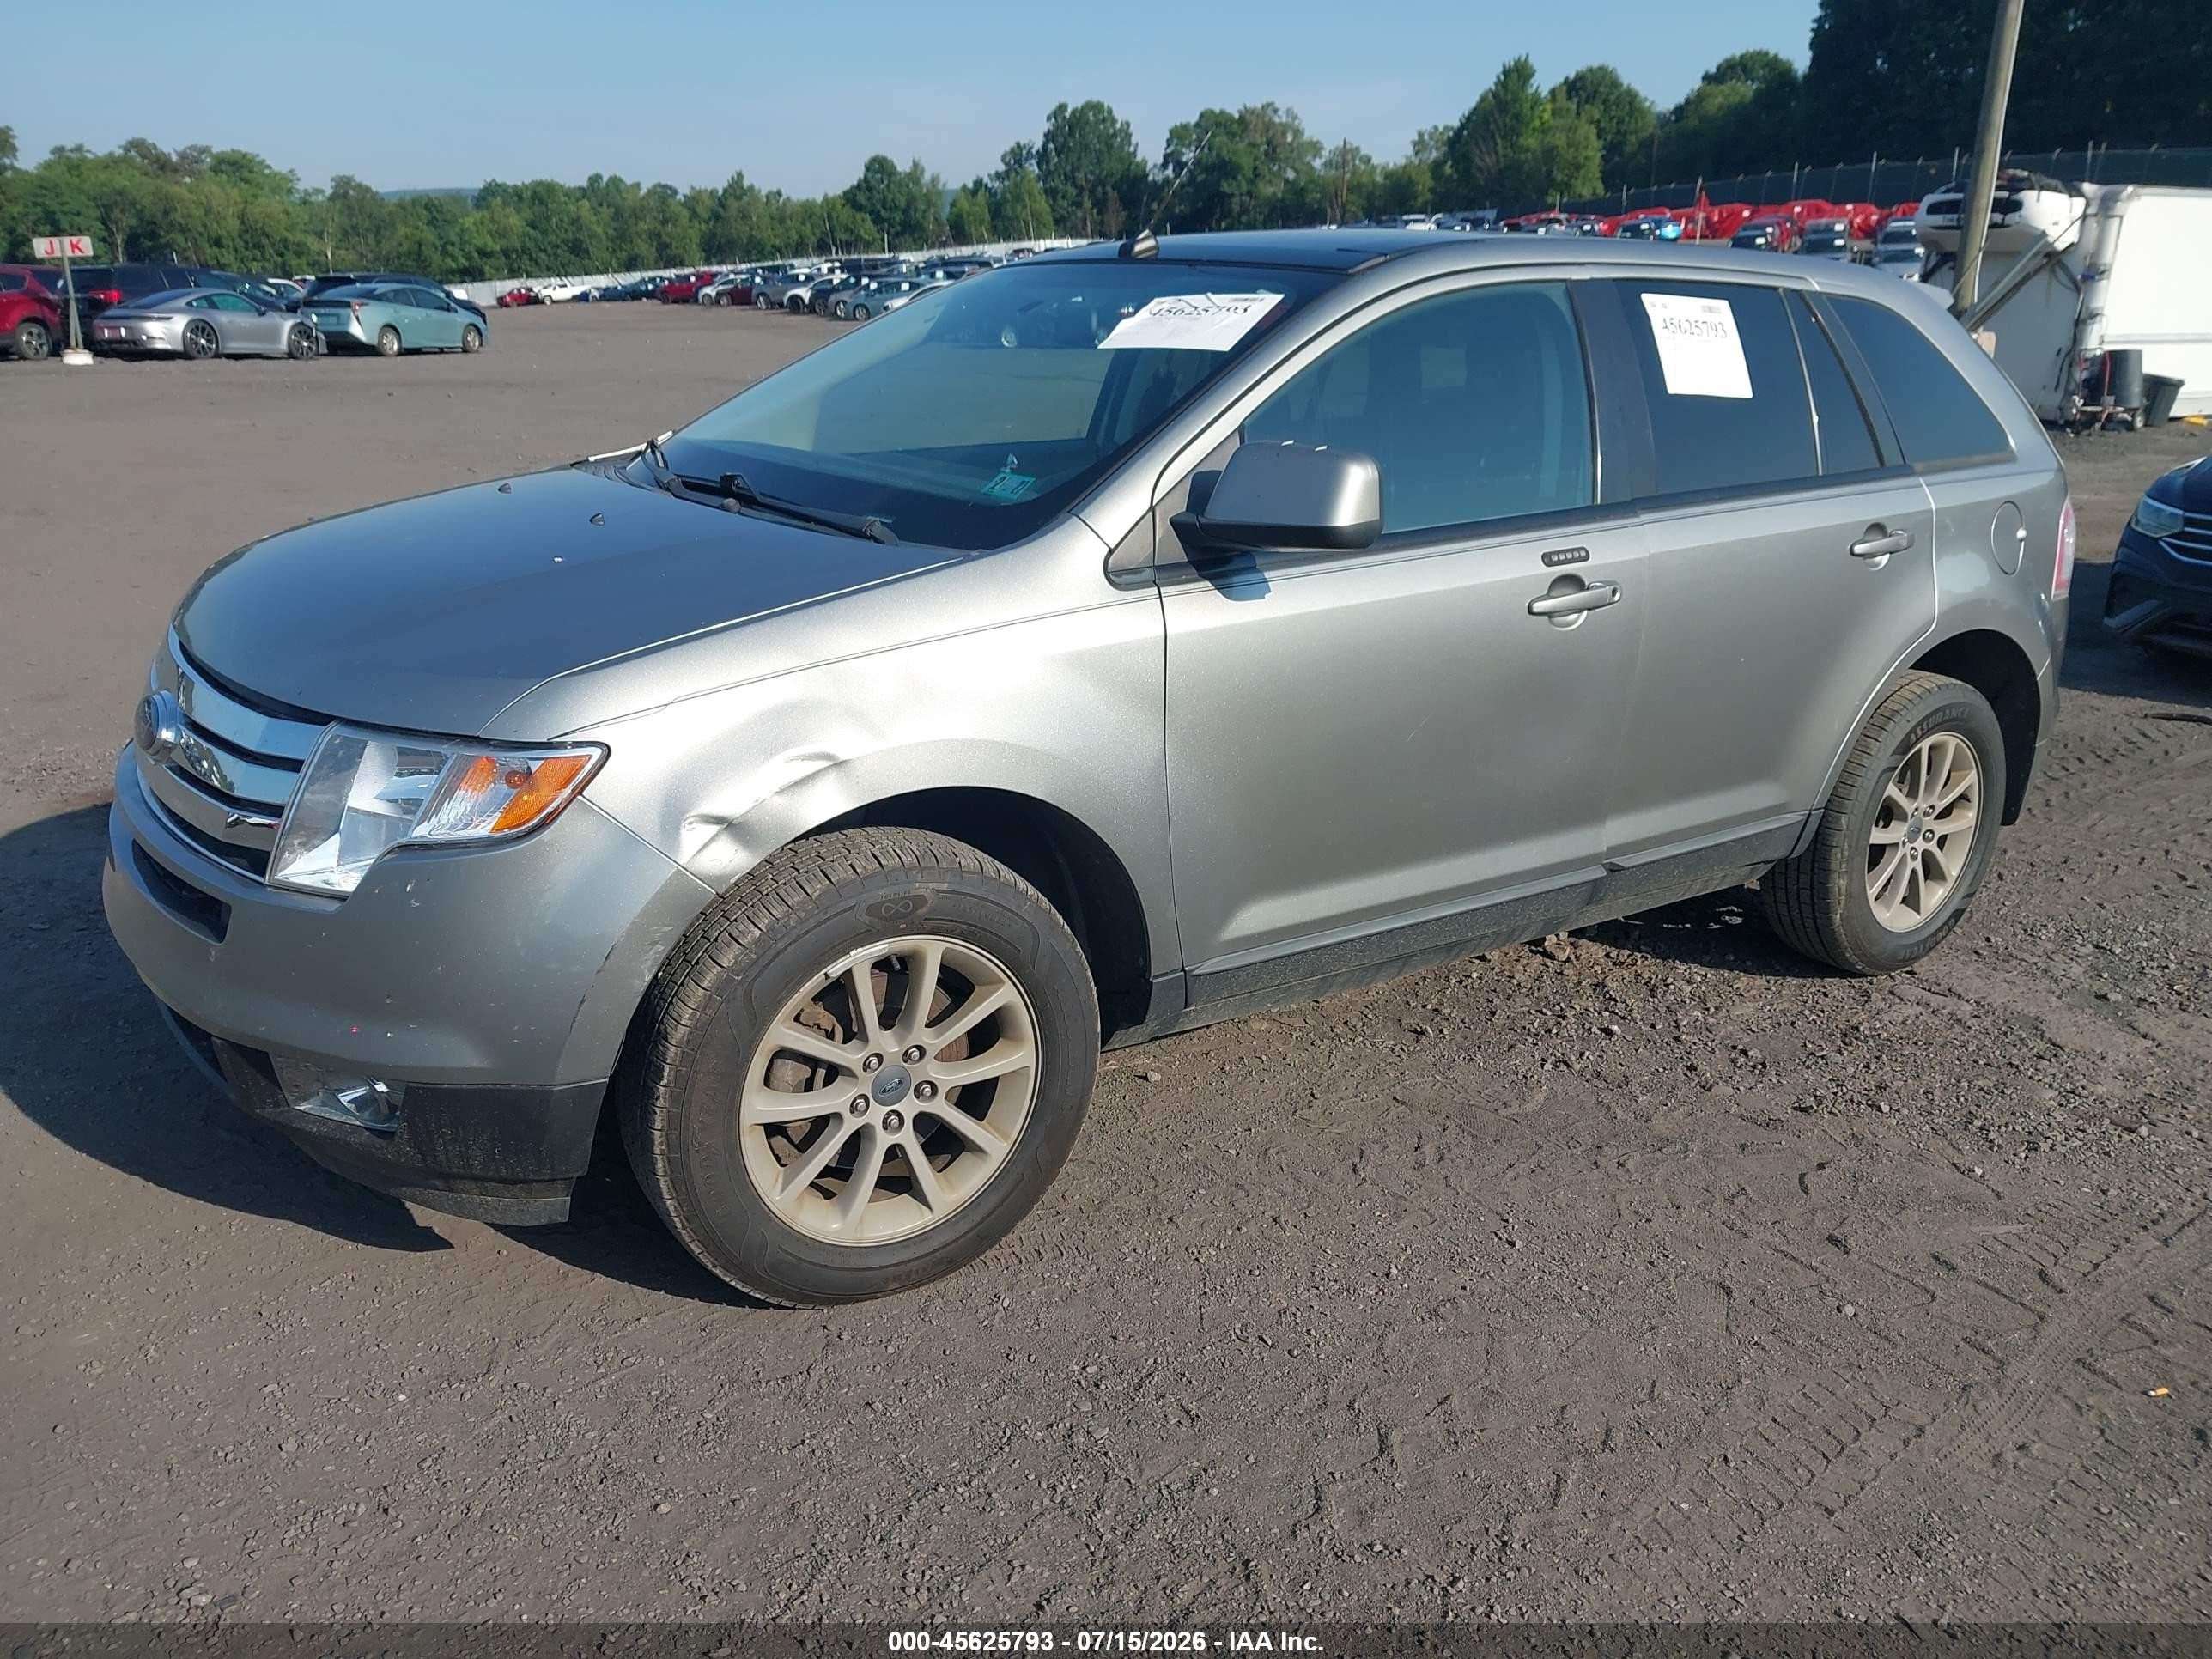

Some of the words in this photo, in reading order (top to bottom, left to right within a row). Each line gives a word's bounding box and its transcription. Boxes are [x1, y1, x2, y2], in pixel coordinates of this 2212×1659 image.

[45, 240, 55, 255] J
[70, 239, 84, 254] K
[1662, 317, 1727, 338] 45625793
